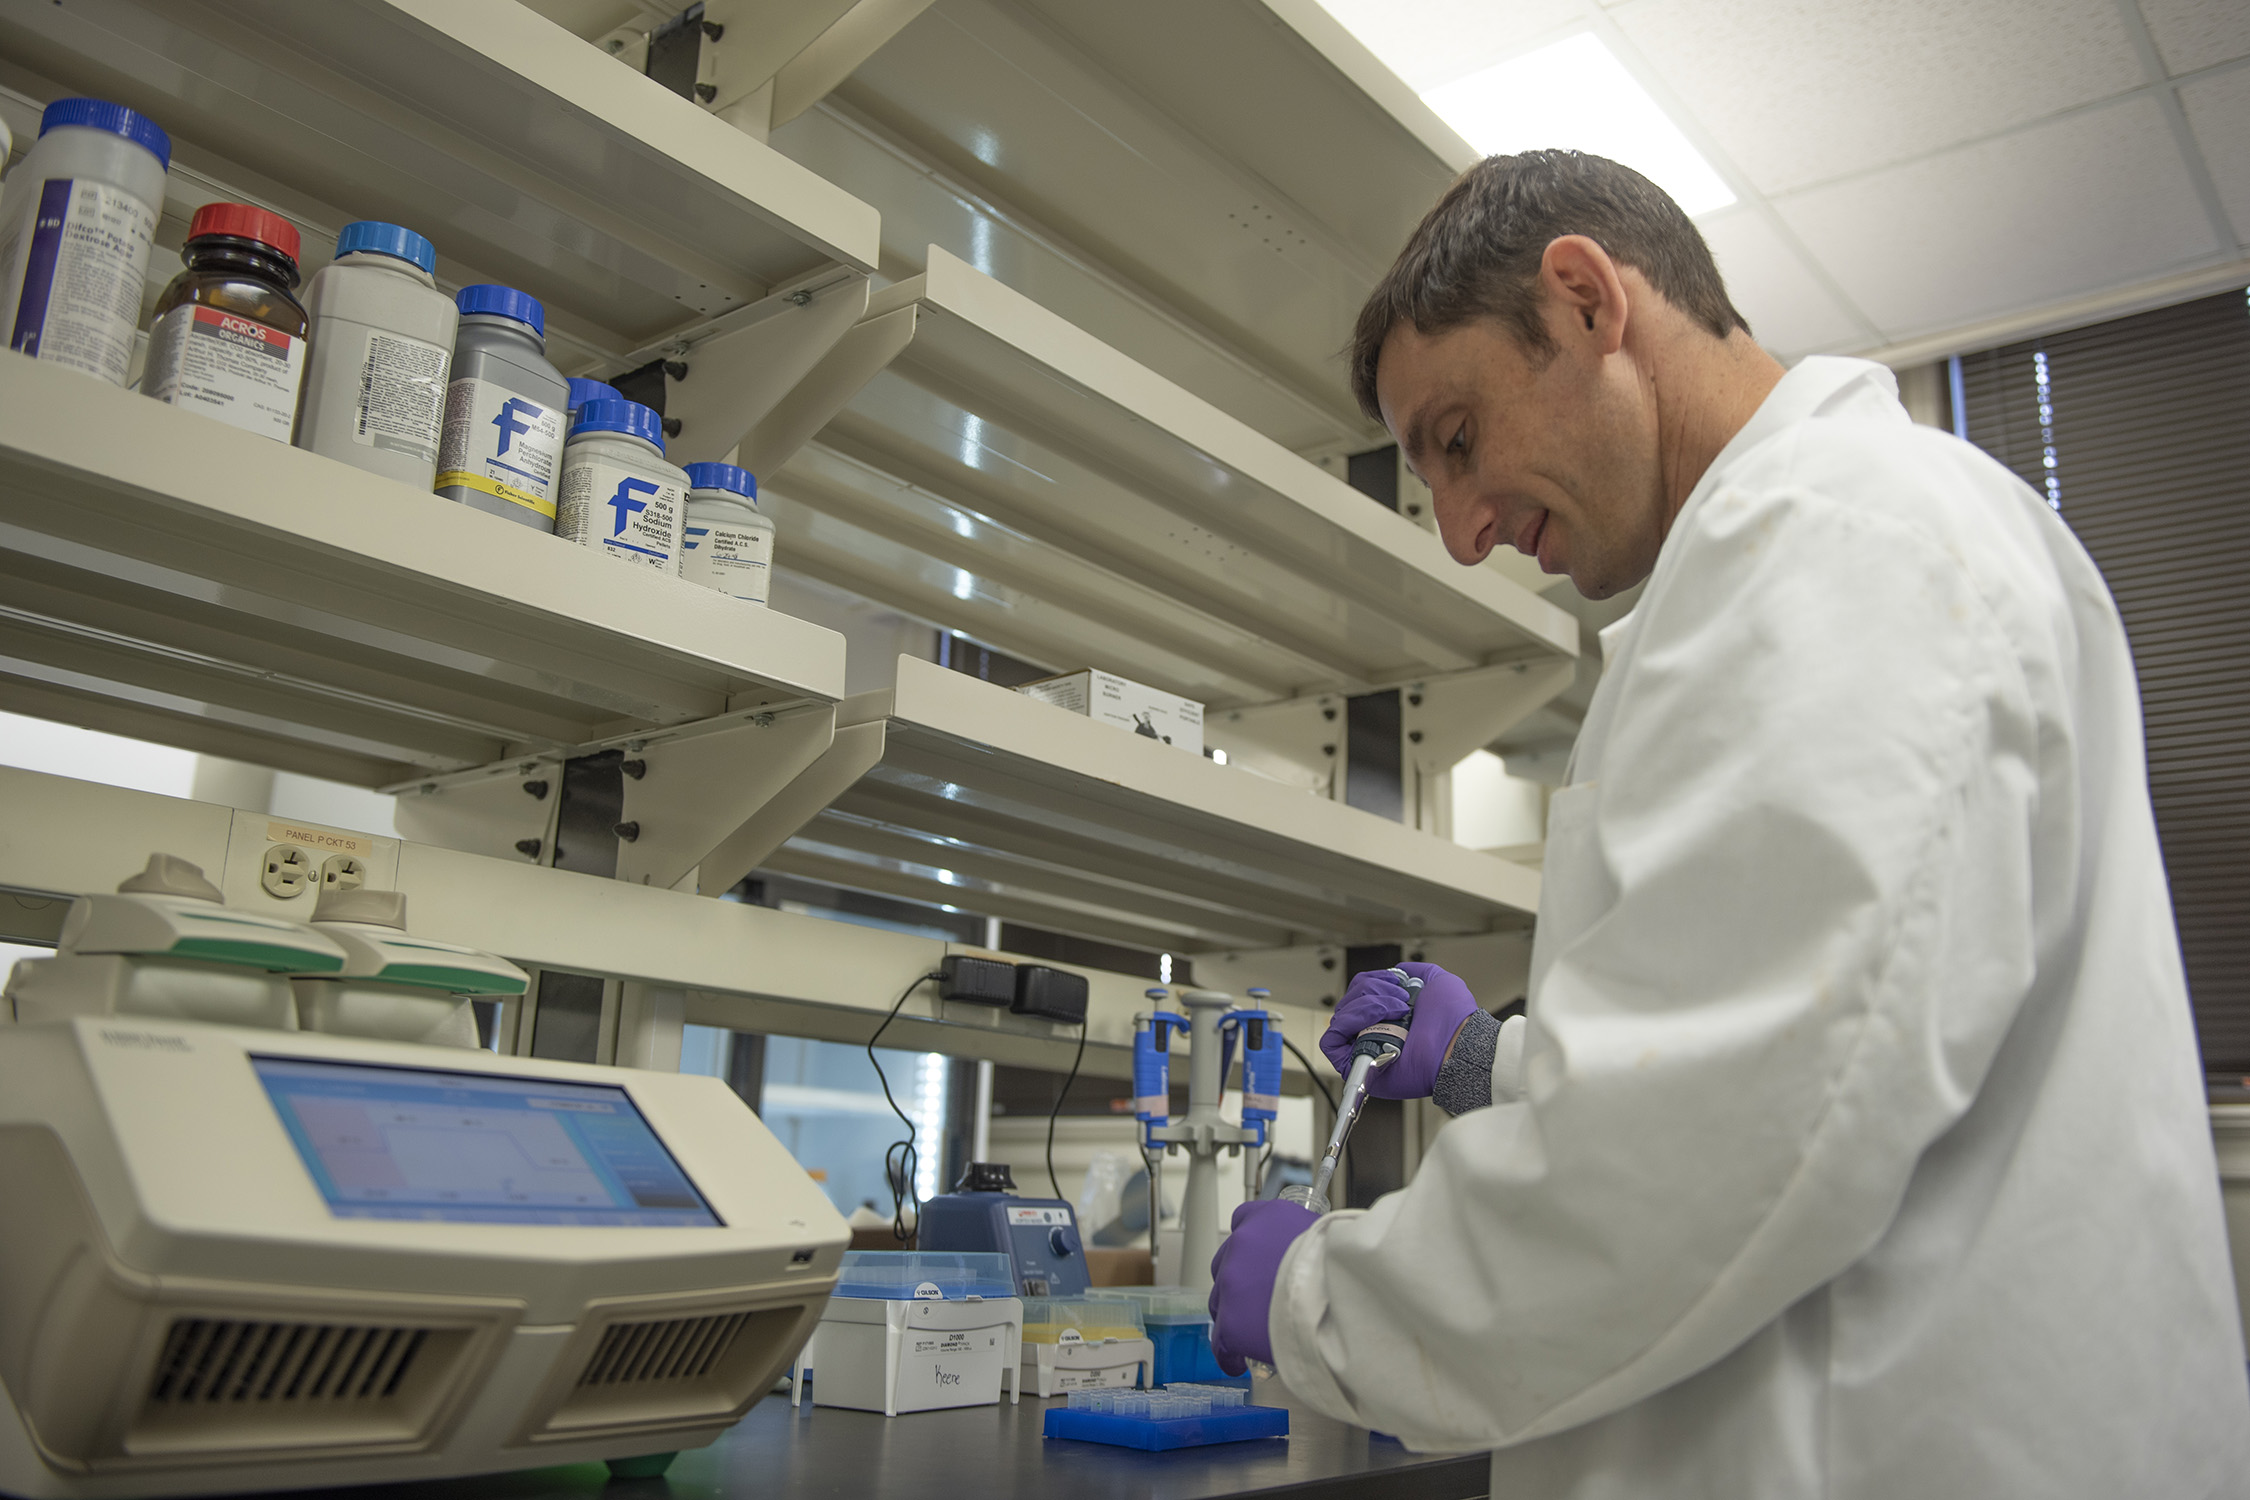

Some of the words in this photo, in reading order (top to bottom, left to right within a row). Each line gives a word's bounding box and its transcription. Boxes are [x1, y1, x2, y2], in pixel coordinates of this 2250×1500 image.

[47, 218, 60, 229] BD
[65, 230, 111, 248] Dextrose
[113, 242, 133, 259] Agar
[107, 231, 135, 252] Potato
[221, 317, 267, 340] ACROS
[218, 329, 265, 351] ORGANICS
[518, 447, 552, 467] Perchlorate
[519, 441, 553, 460] Magnesium
[520, 456, 551, 475] Anhydrous
[655, 501, 667, 510] 500
[668, 506, 674, 514] g
[643, 514, 672, 529] Sodium
[645, 508, 673, 522] S318-500
[633, 521, 672, 538] Hydroxide
[642, 531, 662, 541] Certified
[715, 530, 737, 539] Calcium
[737, 533, 759, 542] Chloride
[656, 540, 671, 549] Pellets
[714, 538, 734, 546] Certified
[714, 543, 736, 551] Dihydrate
[1097, 674, 1127, 687] LABORATORY
[1102, 691, 1121, 700] BURNER
[1105, 684, 1119, 693] MICRO
[285, 829, 315, 843] PANEL
[317, 835, 324, 844] P
[325, 837, 344, 847] CKT
[345, 840, 356, 850] 53
[949, 1333, 965, 1341] D1000
[935, 1364, 960, 1388] Keene
